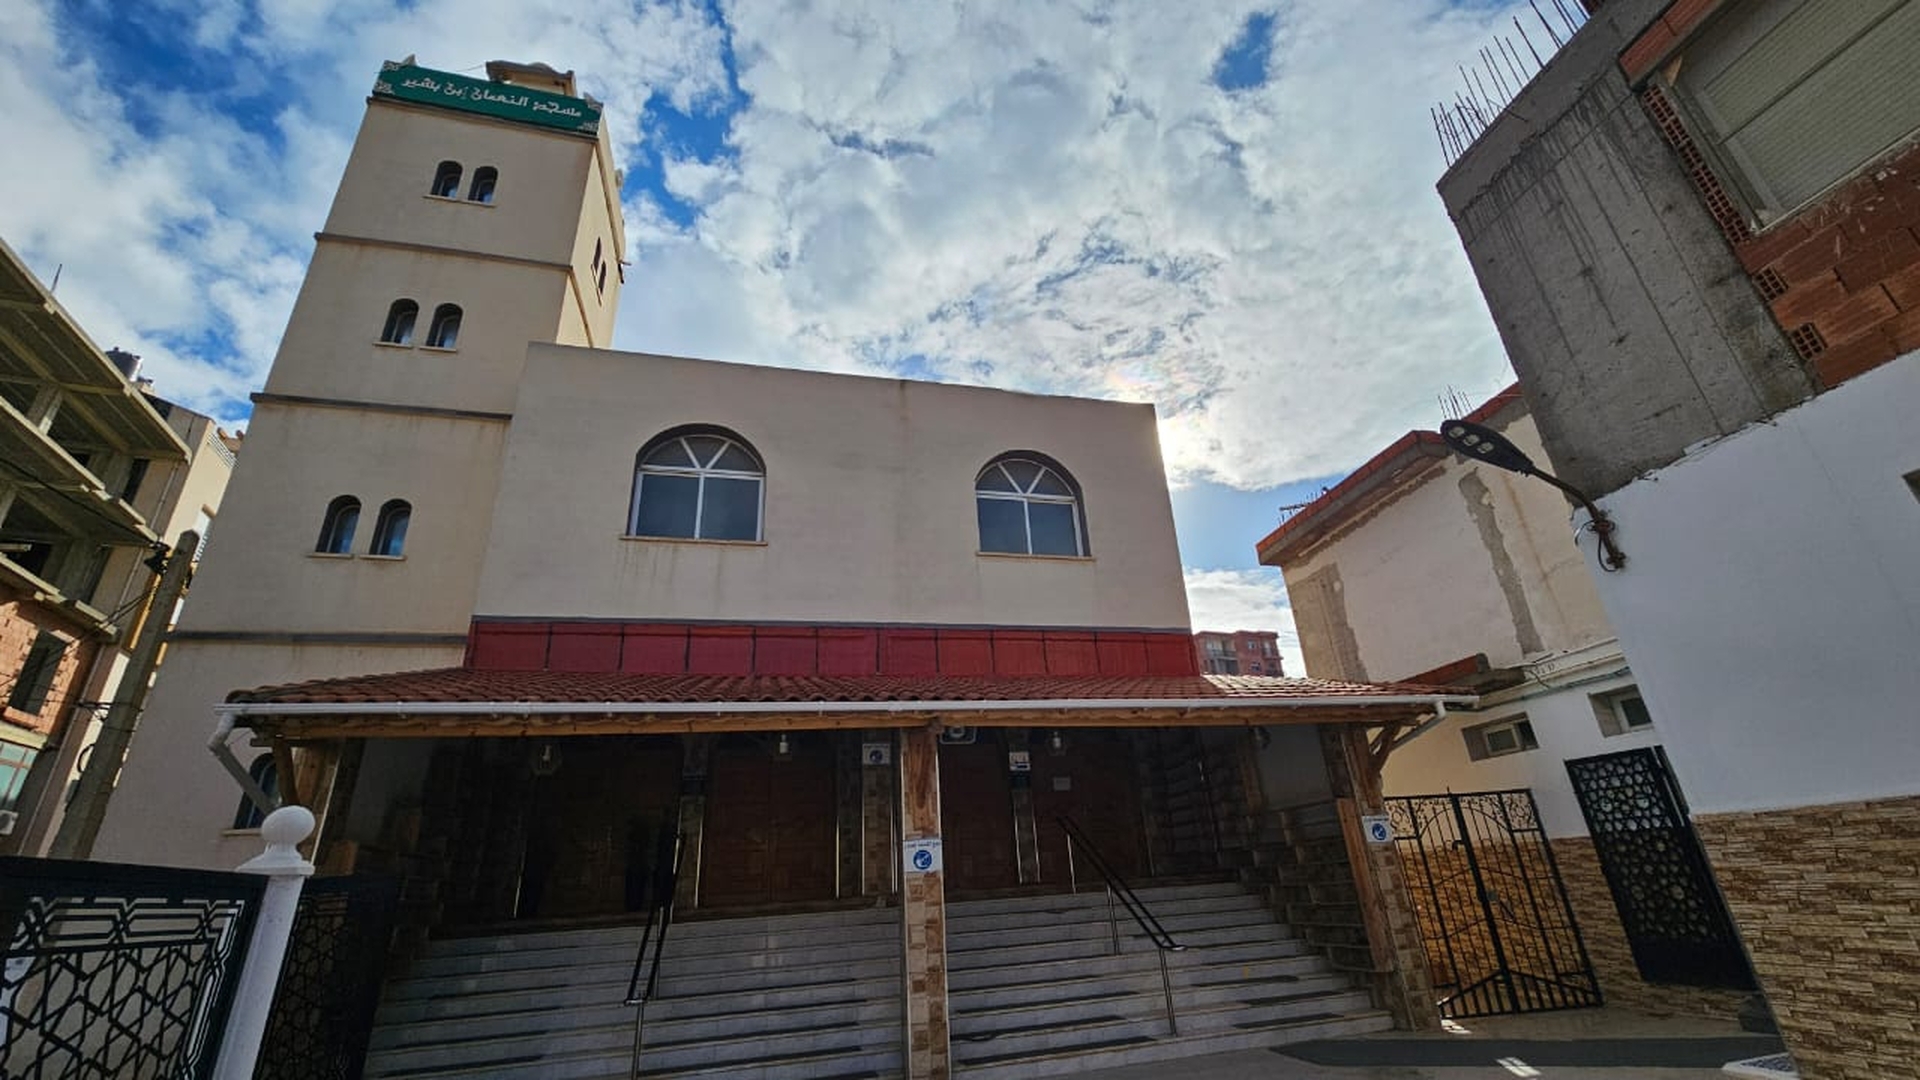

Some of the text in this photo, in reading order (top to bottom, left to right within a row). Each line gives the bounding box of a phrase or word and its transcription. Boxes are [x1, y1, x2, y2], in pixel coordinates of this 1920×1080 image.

[401, 77, 441, 93] بشير
[470, 86, 529, 107] النعمان
[533, 101, 582, 117] مسجد
